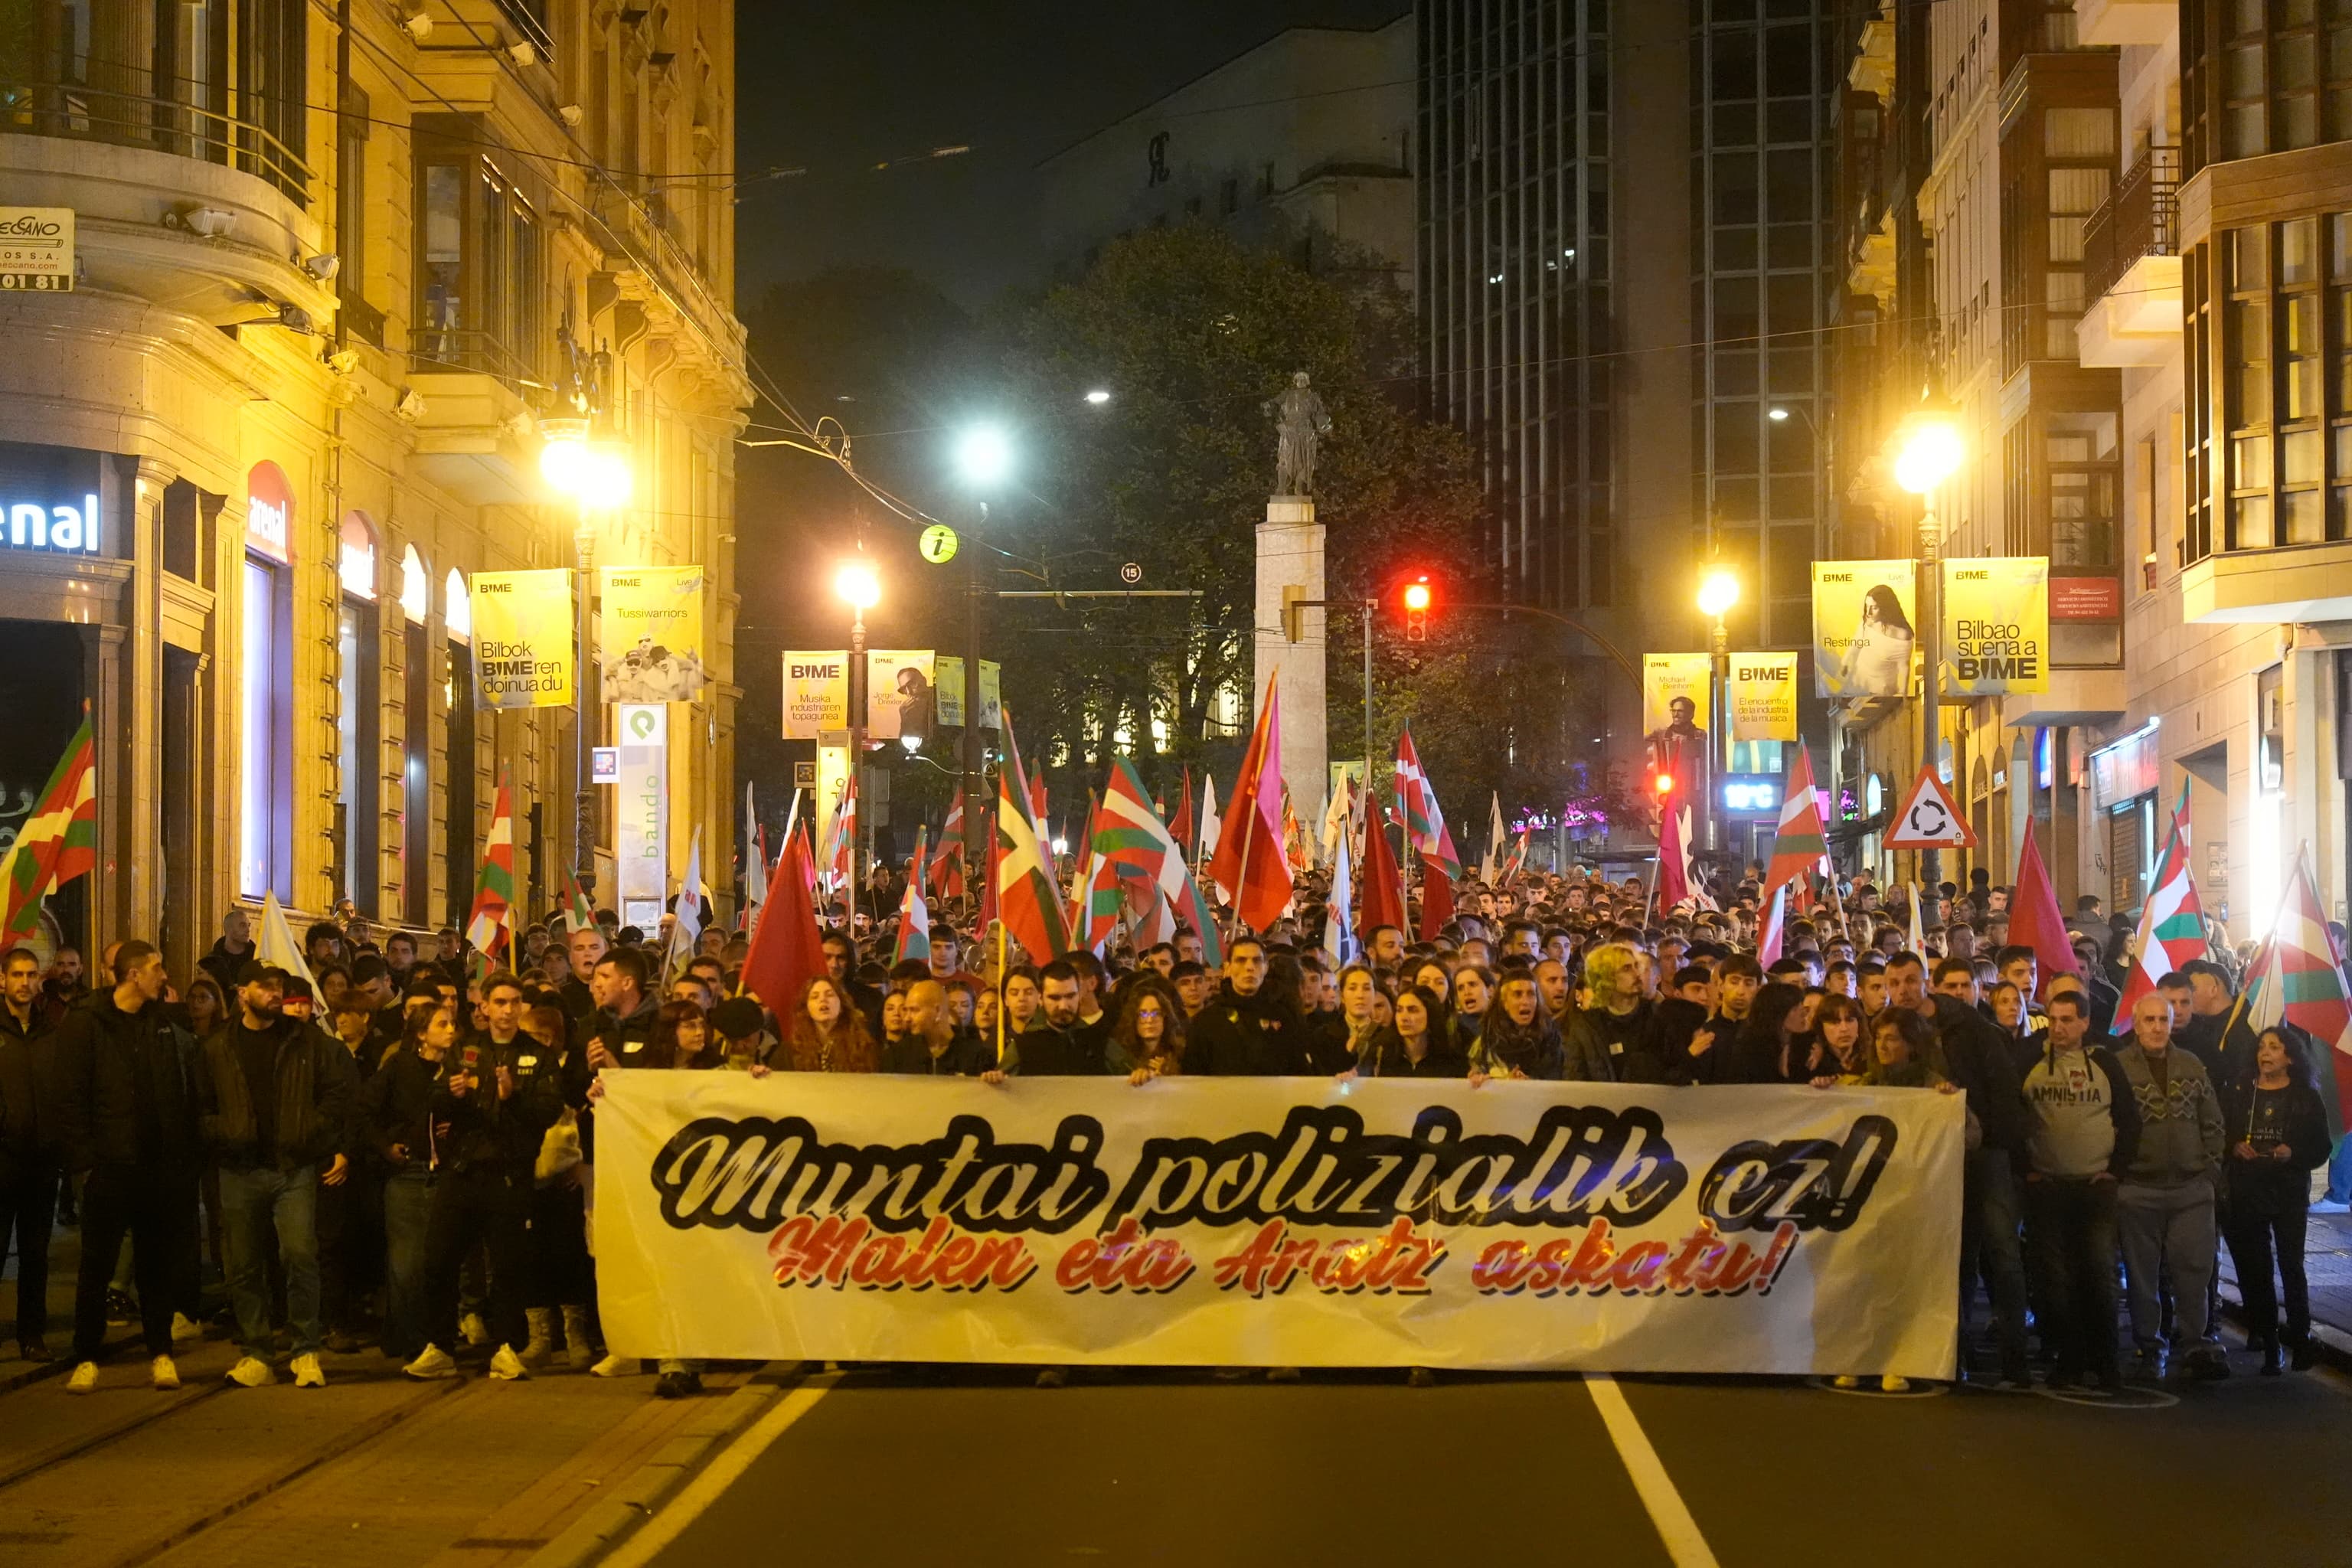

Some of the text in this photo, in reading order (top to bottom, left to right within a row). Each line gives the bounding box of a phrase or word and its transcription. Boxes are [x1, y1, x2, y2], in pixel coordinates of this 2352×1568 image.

[30, 252, 59, 260] S.A.
[2, 274, 59, 289] 01 81
[0, 494, 98, 551] nal
[249, 495, 286, 548] arenal
[1125, 567, 1138, 577] 15
[1823, 573, 1853, 582] BIME
[1956, 570, 1988, 580] BIME
[480, 583, 512, 593] BIME
[612, 577, 693, 587] BIME Live
[616, 607, 688, 619] Tussiwarriors
[1957, 619, 2020, 640] Bilbao
[1824, 636, 1870, 648] Restinga
[482, 640, 533, 658] Bilbok
[1958, 640, 2038, 657] suena a
[482, 660, 562, 677] BIMEren
[791, 665, 840, 678] BIME
[1739, 667, 1788, 681] BIME
[1958, 658, 2037, 681] BIME
[483, 675, 563, 694] doinua du
[799, 694, 831, 703] Musika
[874, 691, 894, 700] Jorge
[1739, 697, 1747, 706] El
[790, 703, 841, 712] industriaren
[1738, 706, 1749, 714] de
[792, 713, 839, 722] topagunea
[1740, 714, 1751, 723] de
[640, 774, 659, 859] bando
[652, 1106, 1899, 1236] Muntai polizialik ez!
[766, 1215, 1798, 1299] Malen eta Aratz askatu!
